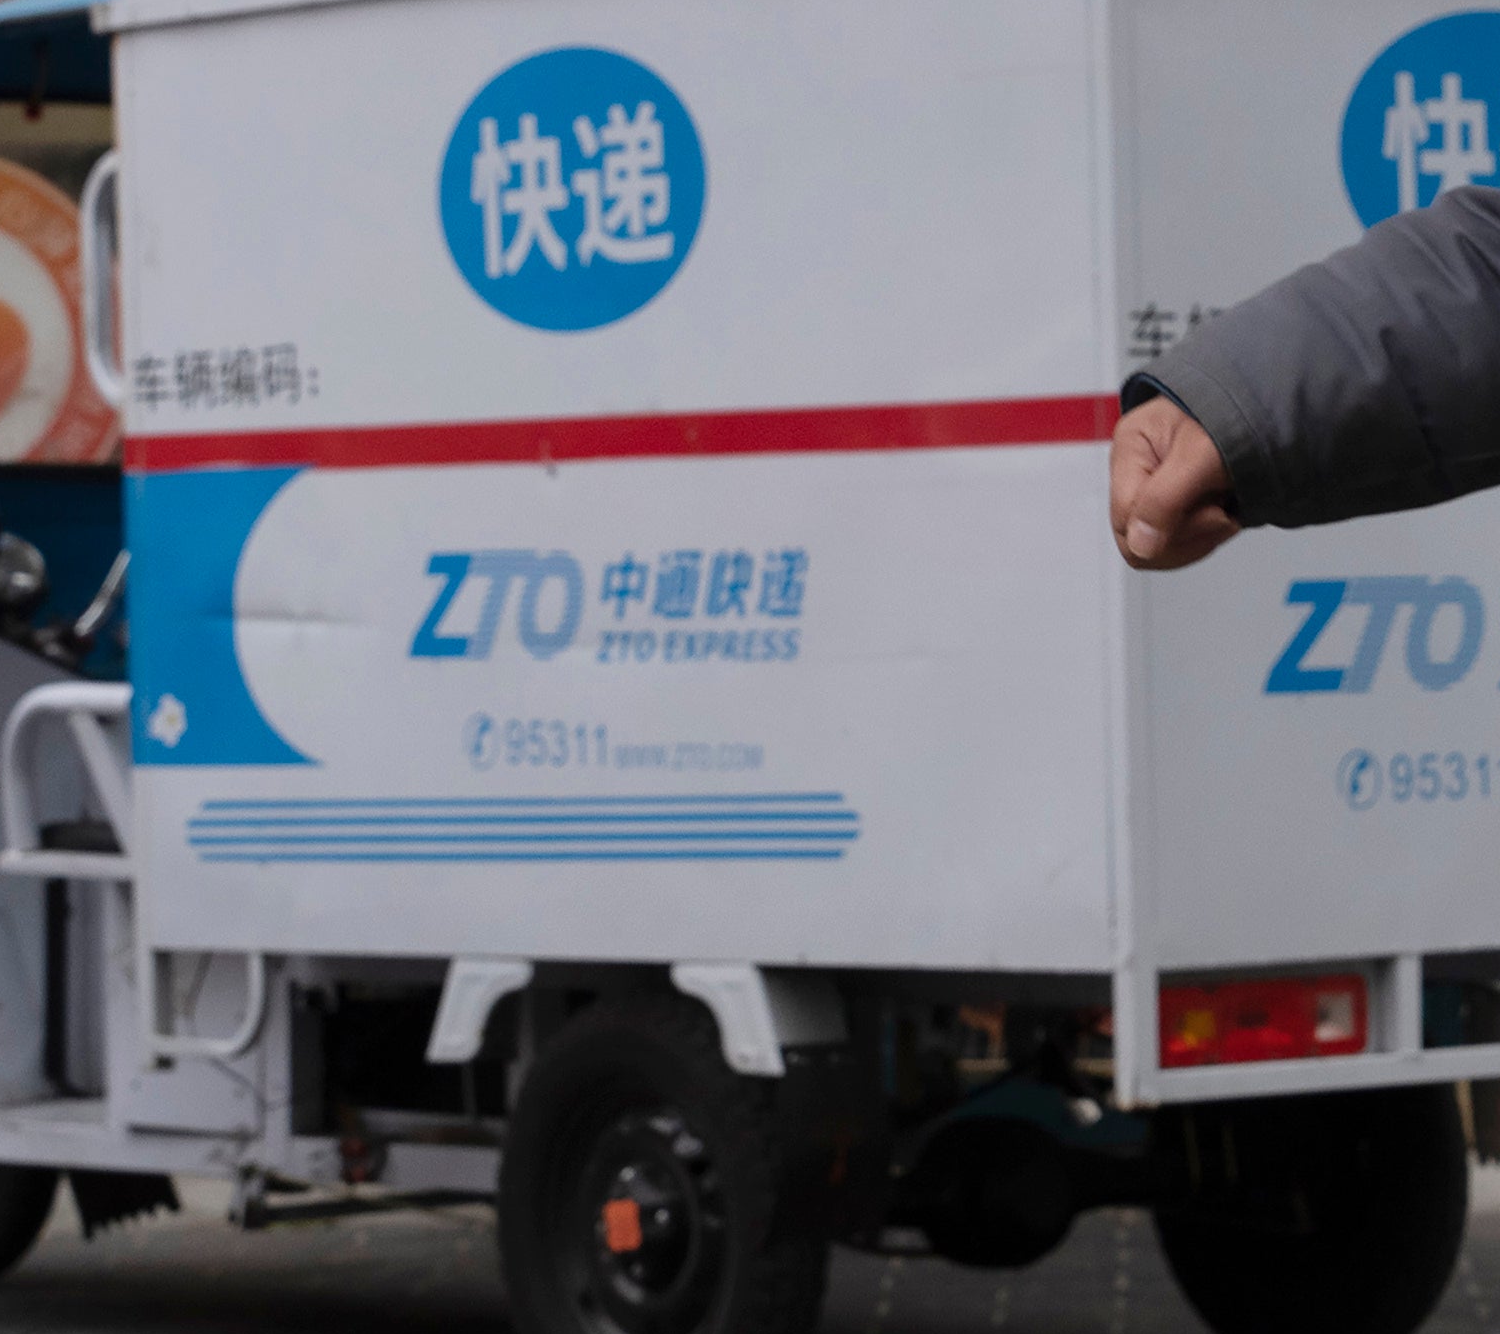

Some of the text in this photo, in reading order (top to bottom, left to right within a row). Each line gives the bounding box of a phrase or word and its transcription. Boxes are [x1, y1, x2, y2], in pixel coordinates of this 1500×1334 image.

[470, 100, 674, 280] 快递
[408, 546, 809, 661] ZTO 中通快递
[596, 625, 804, 665] ZTO EXPRESS
[1263, 575, 1486, 696] ZTO
[504, 719, 609, 769] 95311
